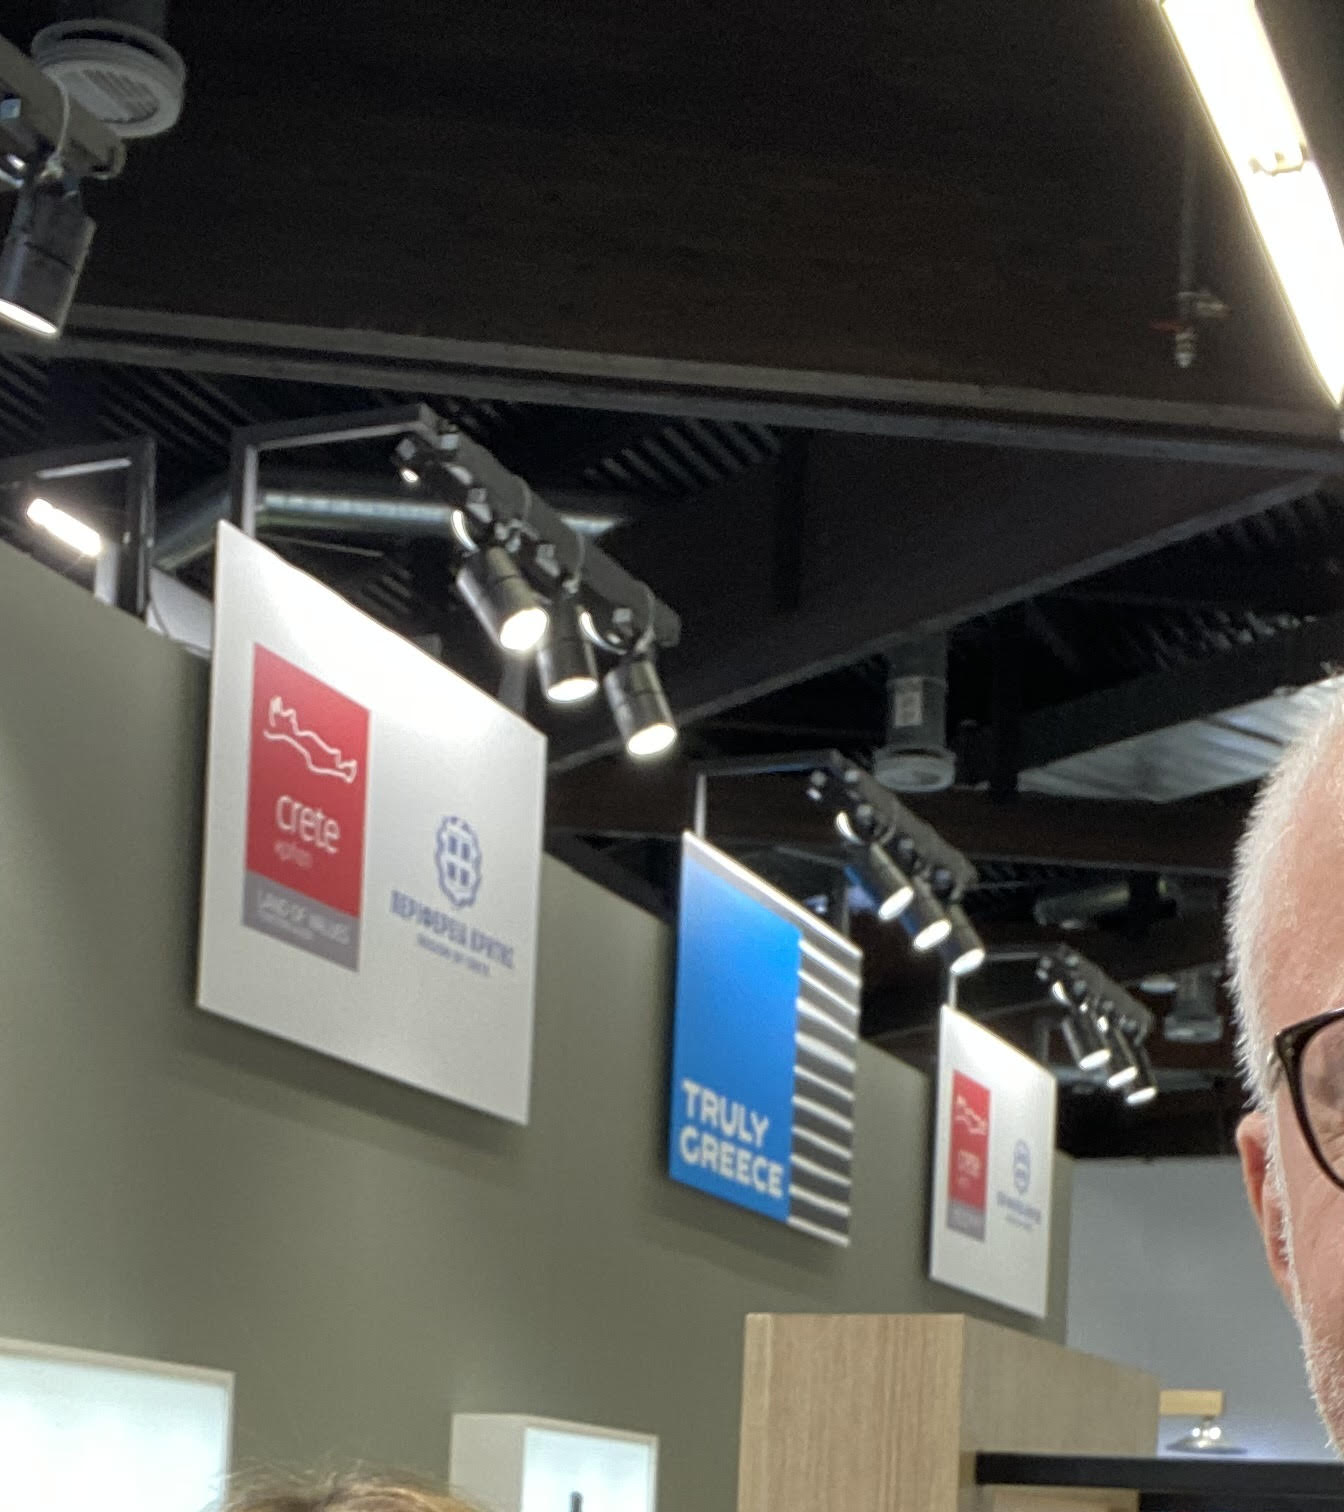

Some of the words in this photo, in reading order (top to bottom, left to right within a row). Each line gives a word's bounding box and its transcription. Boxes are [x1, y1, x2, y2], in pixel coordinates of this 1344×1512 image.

[275, 794, 341, 855] crete
[681, 1077, 770, 1148] TRULY
[679, 1125, 784, 1199] GREECE
